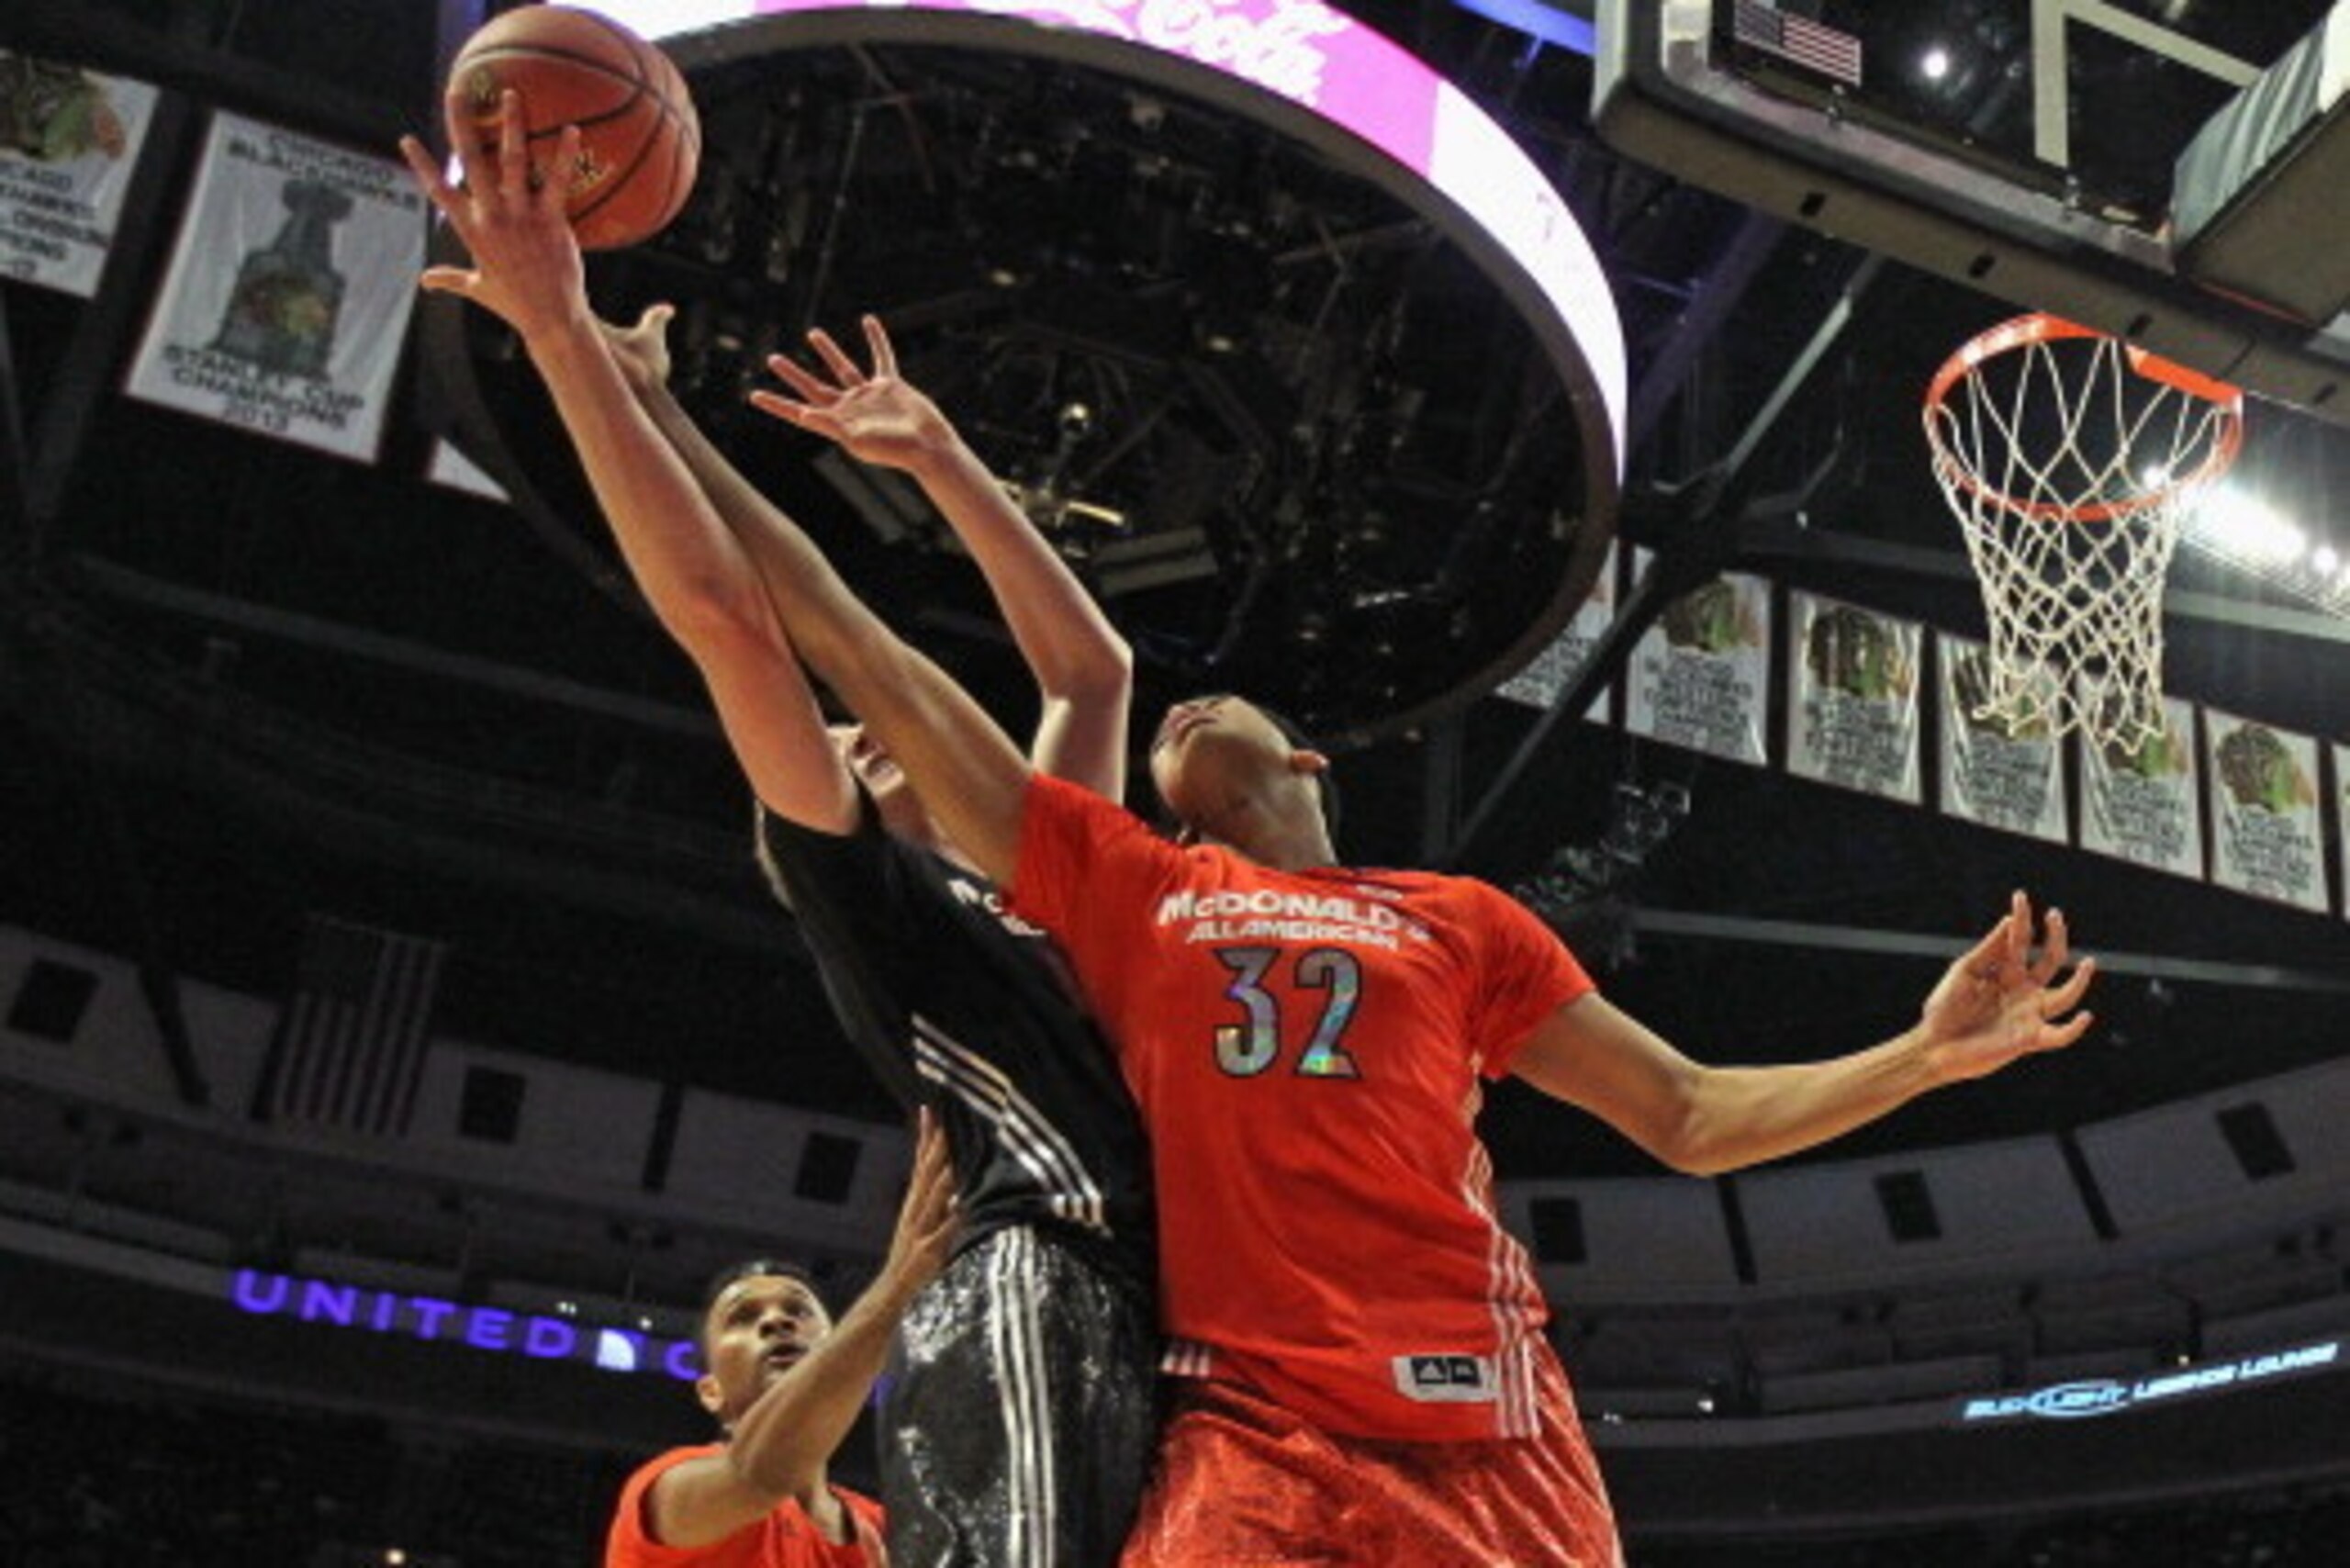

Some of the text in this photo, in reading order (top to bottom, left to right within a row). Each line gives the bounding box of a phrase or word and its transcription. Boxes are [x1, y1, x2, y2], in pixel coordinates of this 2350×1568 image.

[173, 367, 347, 431] CHAMPIONS
[1213, 946, 1362, 1077] 32
[233, 1269, 576, 1358] UNITED
